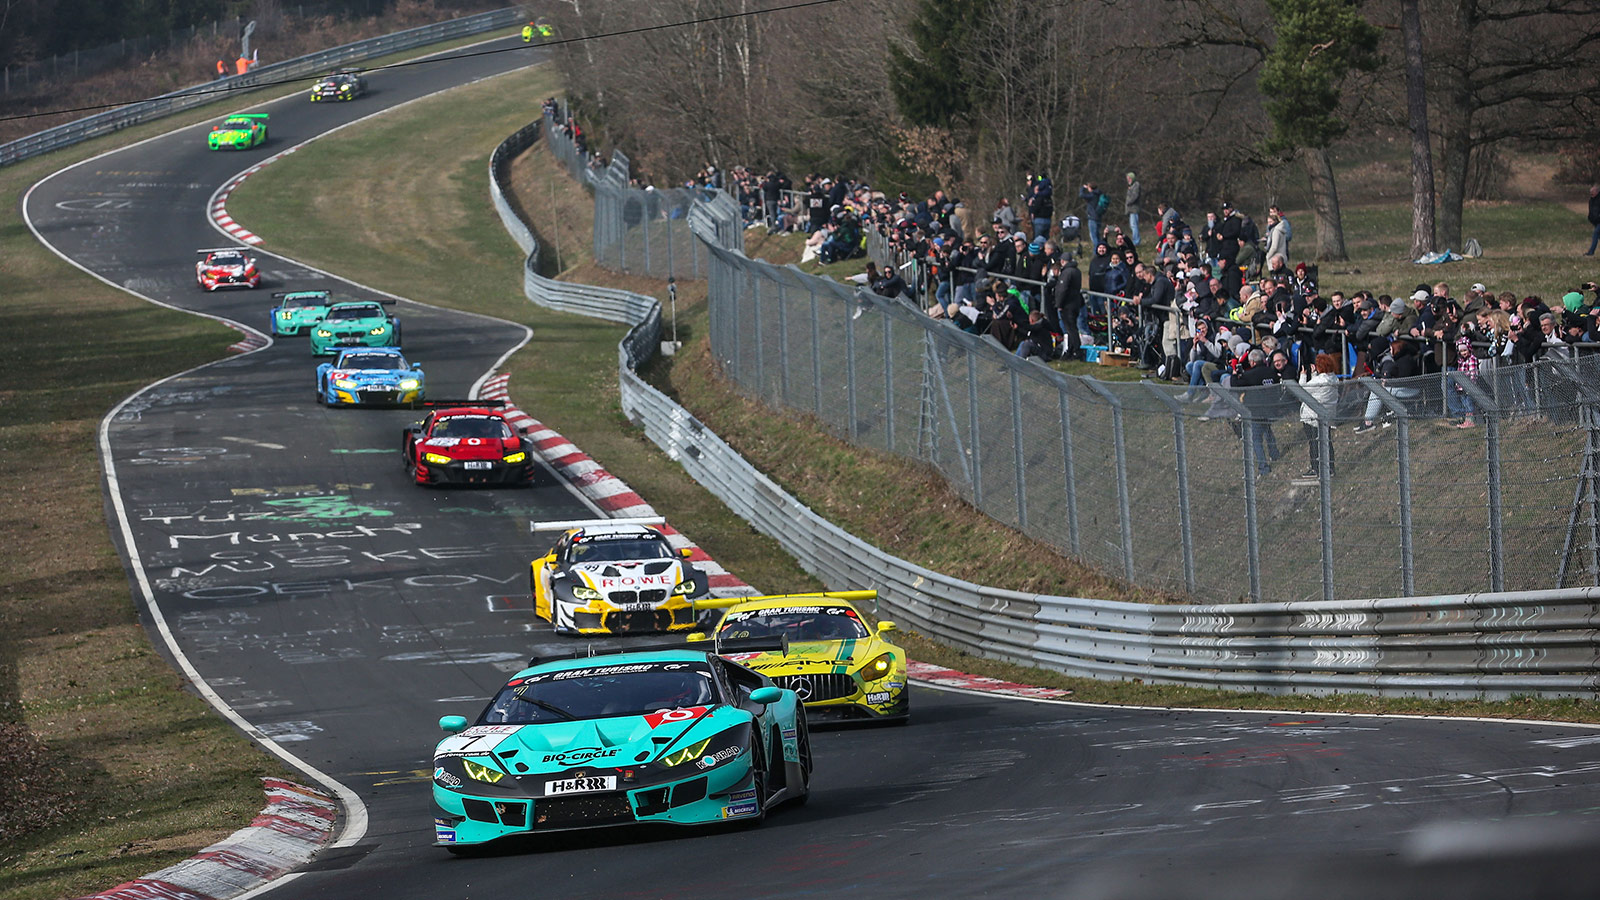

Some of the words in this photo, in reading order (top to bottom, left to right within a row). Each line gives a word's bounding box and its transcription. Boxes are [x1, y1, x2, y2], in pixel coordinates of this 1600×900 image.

[602, 575, 671, 588] ROWE
[758, 607, 782, 616] GRAN
[783, 606, 820, 614] TURISMO
[554, 669, 592, 680] GRAN
[594, 664, 653, 675] TURISMO
[459, 734, 487, 751] 7
[541, 749, 618, 763] BIO-CIRCLE
[695, 745, 741, 770] KONRAD
[734, 806, 755, 814] MICHELIN
